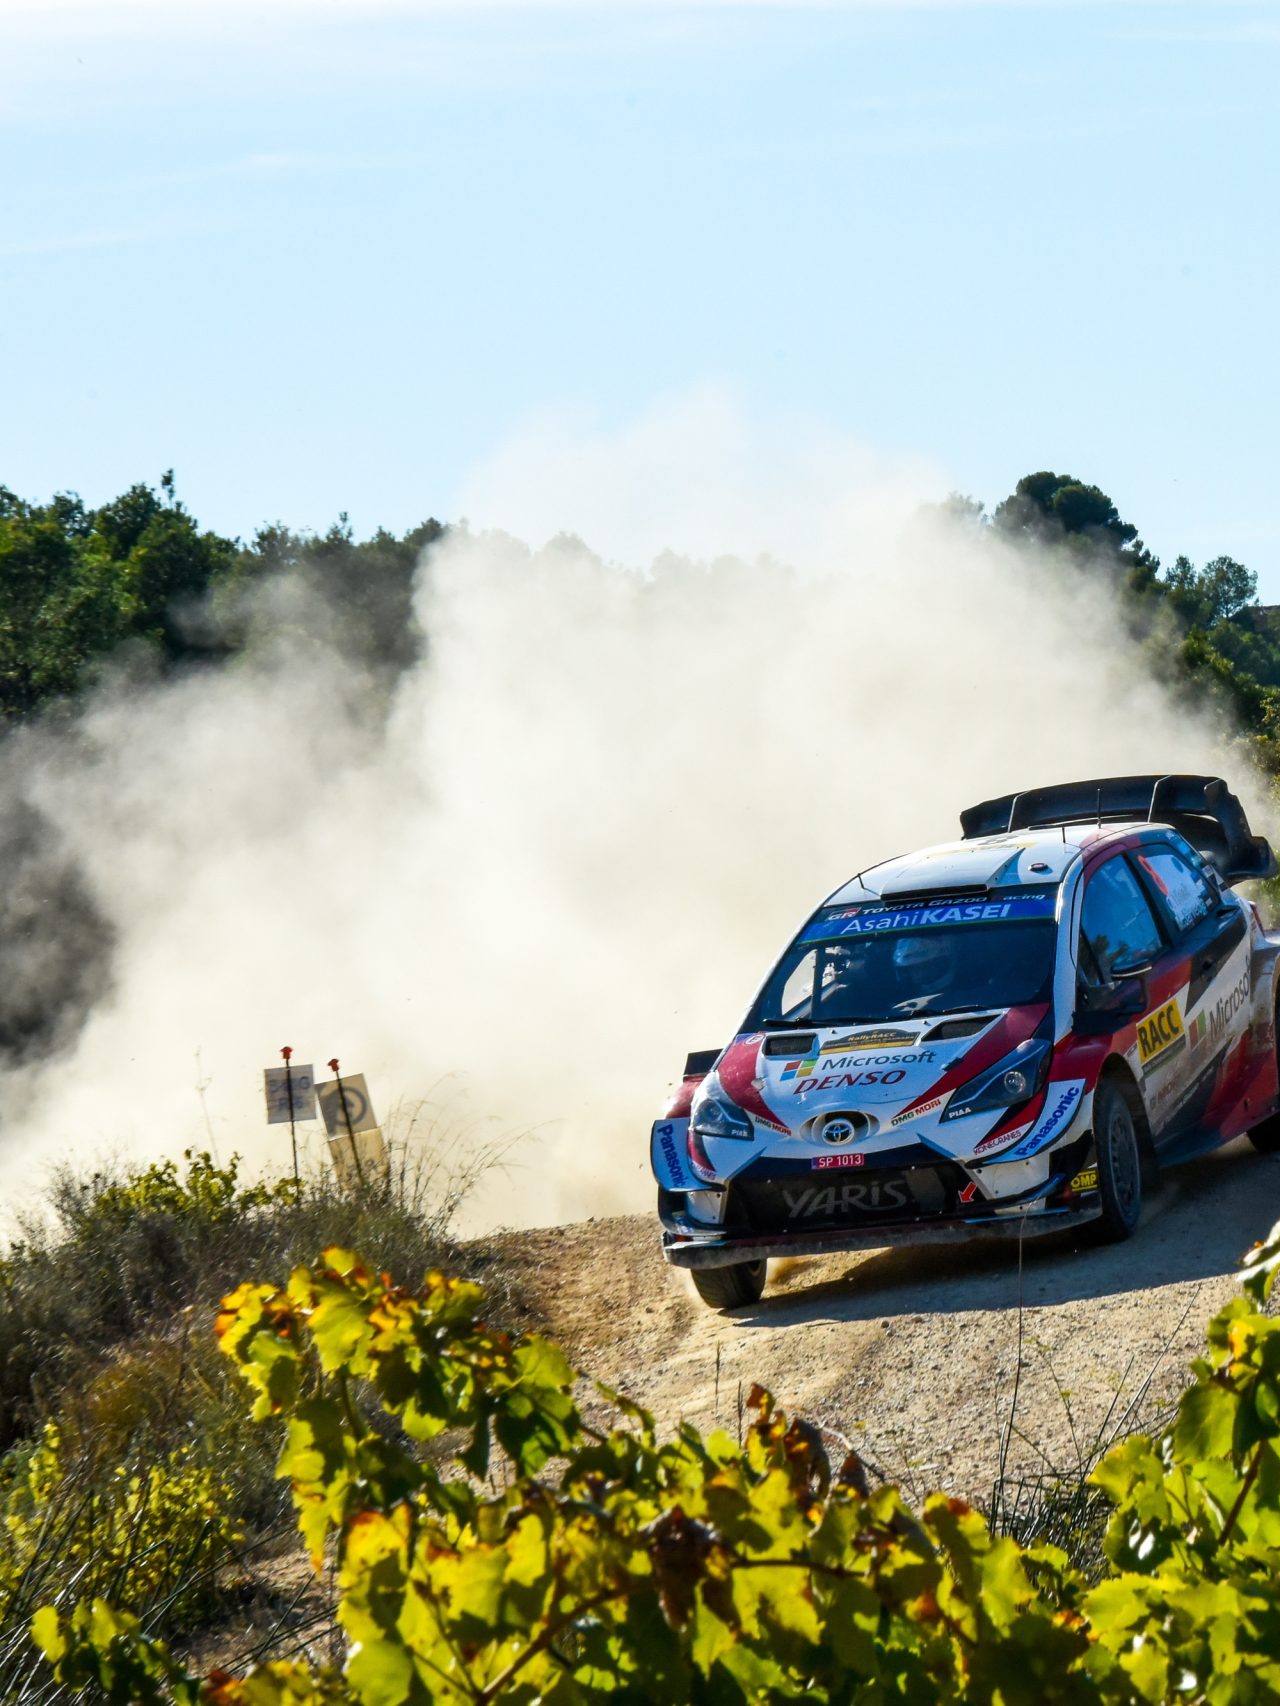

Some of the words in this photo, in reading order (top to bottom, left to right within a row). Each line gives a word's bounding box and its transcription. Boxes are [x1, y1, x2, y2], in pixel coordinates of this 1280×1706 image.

[863, 903, 924, 915] TOYOTA
[928, 897, 987, 907] GAZOO
[1137, 1005, 1179, 1057] RACC
[822, 1051, 936, 1070] Microsoft
[793, 1070, 906, 1095] DENSO
[891, 1111, 914, 1126] DMG
[915, 1098, 941, 1115] MORI
[949, 1107, 972, 1119] PIAA
[1015, 1086, 1080, 1157] Panasonic
[973, 1131, 1021, 1155] KONECRANES
[657, 1124, 689, 1187] Panasonic
[819, 1156, 833, 1168] SP
[837, 1153, 863, 1166] 1013
[1071, 1174, 1097, 1188] OMP
